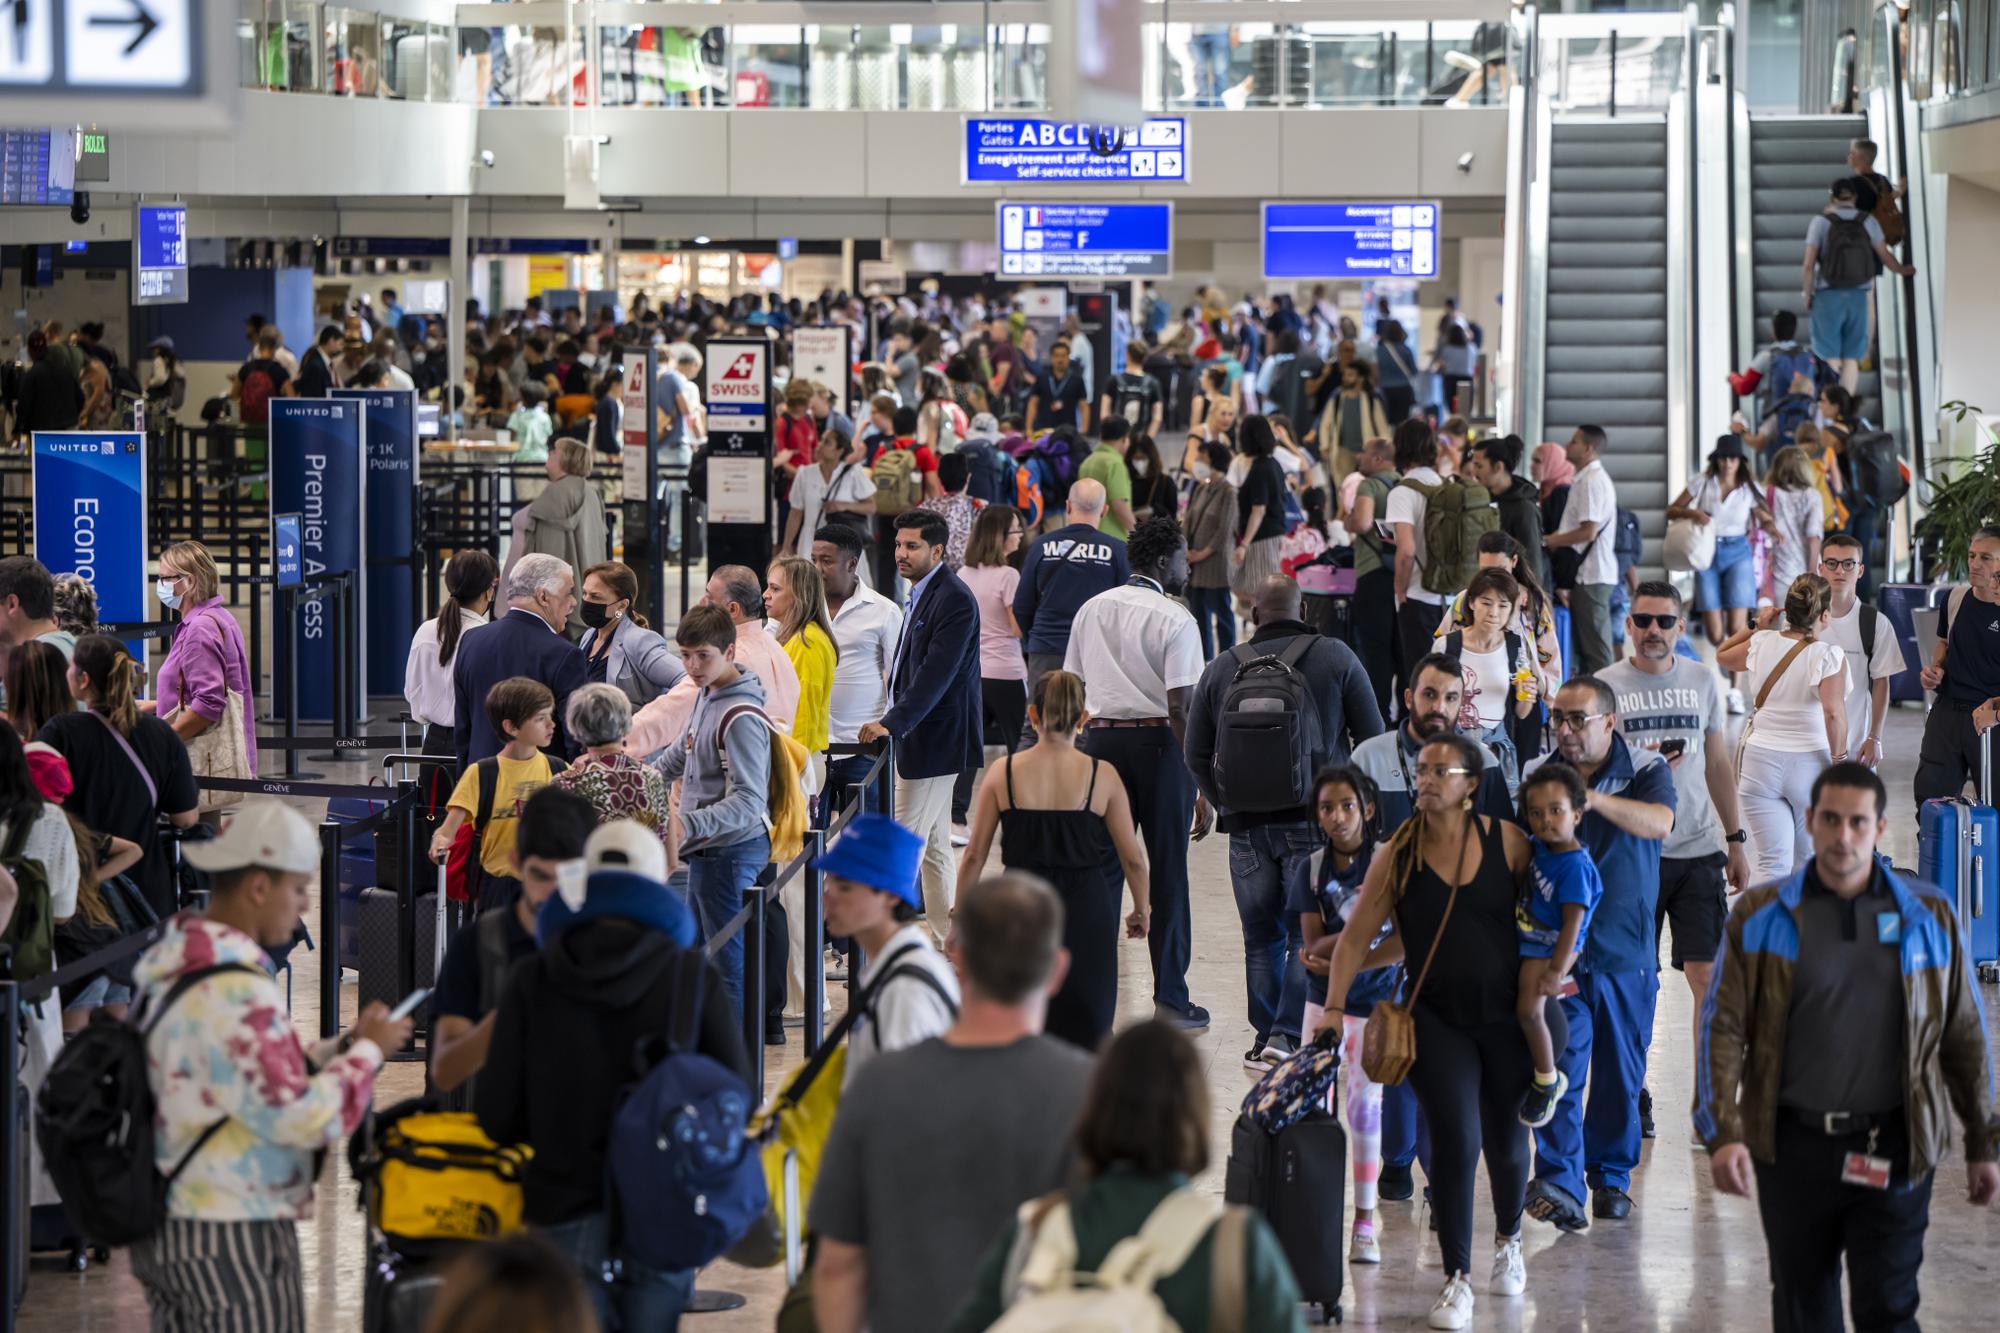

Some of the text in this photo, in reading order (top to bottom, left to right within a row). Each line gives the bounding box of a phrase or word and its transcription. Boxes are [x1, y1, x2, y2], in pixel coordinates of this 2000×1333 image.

[978, 123, 1014, 133] Portes
[85, 135, 105, 153] ROLEX
[981, 135, 1014, 146] Gates
[978, 153, 1128, 167] Enregistrement self-service
[1017, 166, 1128, 177] Self-service check-in
[1077, 231, 1090, 249] F
[711, 384, 760, 396] SWISS
[285, 407, 329, 417] UNITED
[50, 443, 98, 453] UNITED
[379, 443, 395, 455] 1K
[370, 458, 409, 471] Polaris
[74, 498, 99, 591] Econo
[304, 454, 328, 639] Premier Aess
[1617, 688, 1699, 713] HOLLISTER
[1628, 717, 1697, 729] SURFING
[336, 738, 367, 747] GENÈVE
[263, 782, 289, 793] GENÈVE
